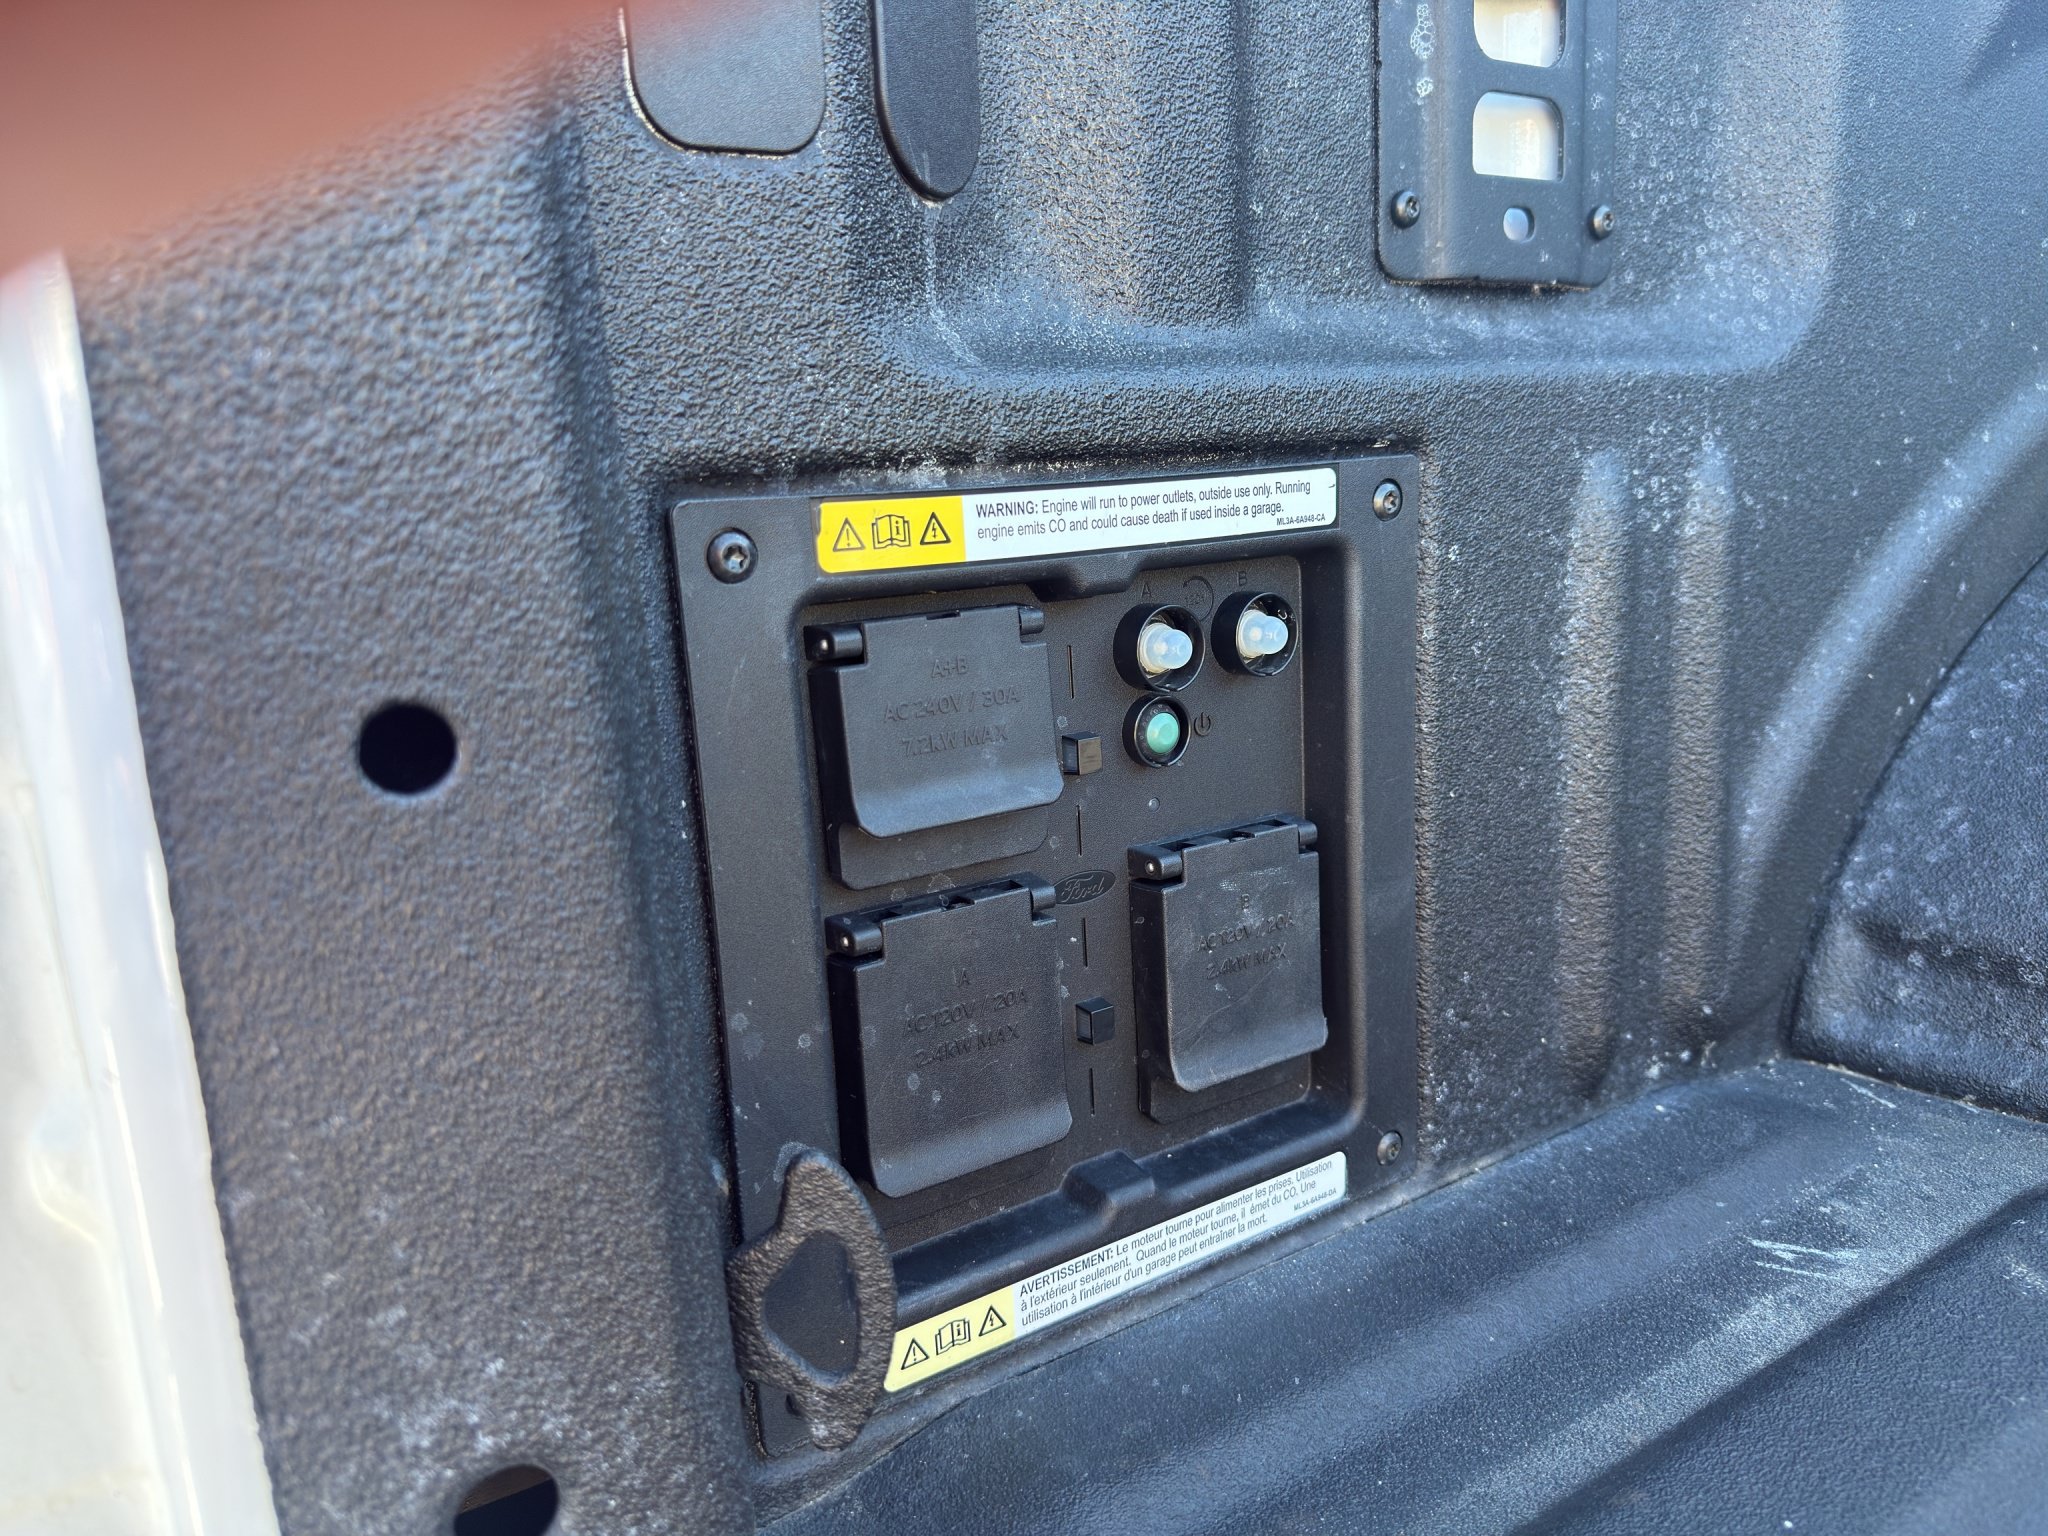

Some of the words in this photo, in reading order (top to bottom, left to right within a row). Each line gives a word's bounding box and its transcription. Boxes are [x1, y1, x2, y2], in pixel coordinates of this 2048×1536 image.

[976, 501, 1038, 518] WARNING:
[1042, 499, 1078, 516] Engine
[1081, 496, 1097, 510] will
[1100, 498, 1116, 509] run
[1119, 495, 1127, 507] to
[1131, 494, 1160, 509] power
[1163, 490, 1197, 504] outlets,
[1199, 487, 1232, 500] outside
[1234, 487, 1250, 498] use
[1253, 483, 1273, 499] only.
[1276, 480, 1311, 495] Running
[978, 523, 1014, 542] engine
[1018, 522, 1045, 536] emits
[1049, 518, 1066, 533] CO
[1070, 517, 1088, 531] and
[1091, 514, 1117, 529] could
[1121, 513, 1150, 527] cause
[1153, 509, 1179, 524] death
[1181, 508, 1187, 521] if
[1190, 506, 1212, 520] used
[1215, 504, 1241, 518] inside
[1243, 505, 1249, 515] a
[1251, 502, 1284, 518] garage.
[1276, 513, 1326, 526] ML3A-6A948-CA
[1141, 583, 1151, 598] A
[1236, 571, 1248, 587] B
[931, 656, 969, 679] A+B
[982, 686, 1020, 708] 30A
[964, 725, 1008, 747] MAX
[1061, 875, 1105, 903] Ford
[1255, 942, 1286, 965] MAX
[993, 987, 1027, 1011] 20A
[978, 1022, 1020, 1050] MAX
[1020, 1247, 1114, 1297] AVERTISSEMENT:
[1117, 1243, 1129, 1256] Le
[1132, 1229, 1163, 1250] moteur
[1165, 1217, 1193, 1235] tourne
[1195, 1207, 1217, 1227] pour
[1216, 1192, 1256, 1215] alimenter
[1255, 1187, 1267, 1199] les
[1269, 1176, 1294, 1194] prises.
[1296, 1161, 1332, 1182] Utilisation
[1021, 1300, 1028, 1312] à
[1030, 1280, 1077, 1306] l'extérieur
[1080, 1258, 1132, 1286] seulement.
[1136, 1240, 1166, 1262] Quand
[1169, 1236, 1177, 1249] le
[1179, 1224, 1208, 1244] moteur
[1211, 1213, 1239, 1230] tourne,
[1241, 1209, 1246, 1218] il
[1250, 1198, 1270, 1215] émet
[1272, 1193, 1282, 1206] du
[1283, 1186, 1298, 1201] CO.
[1301, 1180, 1316, 1193] Une
[1022, 1299, 1068, 1326] utilisation
[1071, 1294, 1077, 1305] à
[1080, 1274, 1121, 1301] l'intérieur
[1124, 1266, 1143, 1281] d'un
[1145, 1252, 1176, 1275] garage
[1179, 1241, 1198, 1261] peut
[1199, 1228, 1236, 1249] entraîner
[1238, 1222, 1245, 1233] la
[1247, 1214, 1268, 1230] mort.
